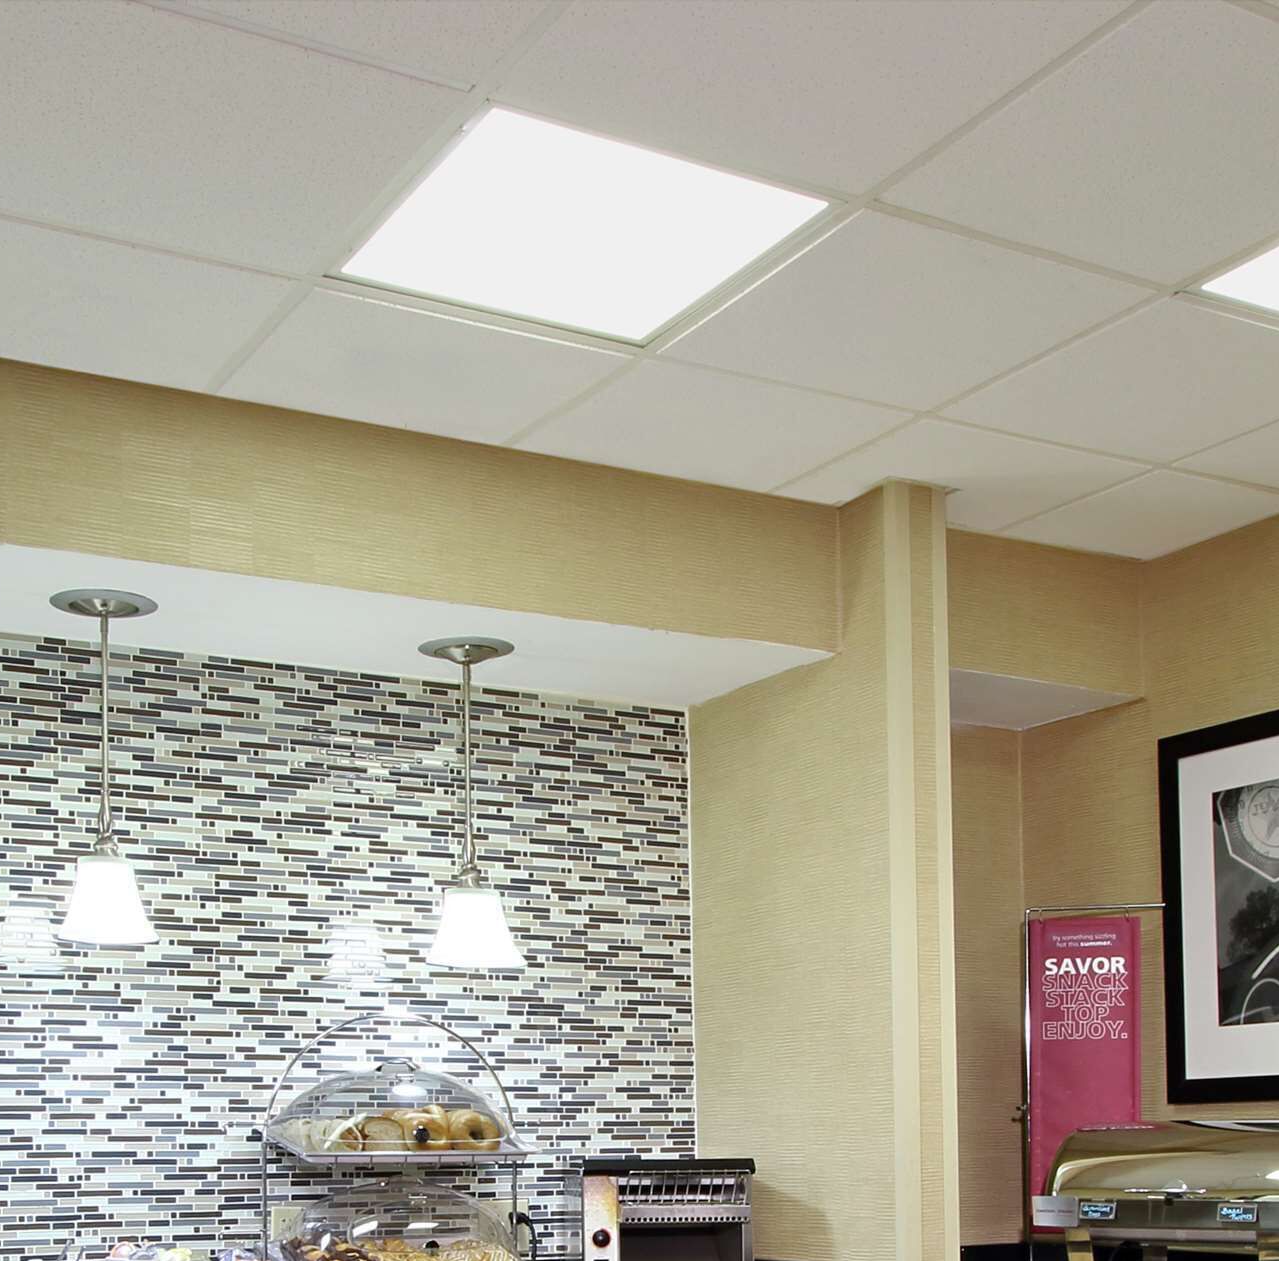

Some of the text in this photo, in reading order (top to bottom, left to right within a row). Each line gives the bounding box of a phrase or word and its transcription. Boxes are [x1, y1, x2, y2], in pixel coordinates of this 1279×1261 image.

[1044, 956, 1127, 975] SAVOR
[1042, 971, 1129, 992] SNACK
[1045, 987, 1126, 1008] STACK
[1061, 1004, 1109, 1023] TOP
[1042, 1020, 1128, 1040] ENJOY.
